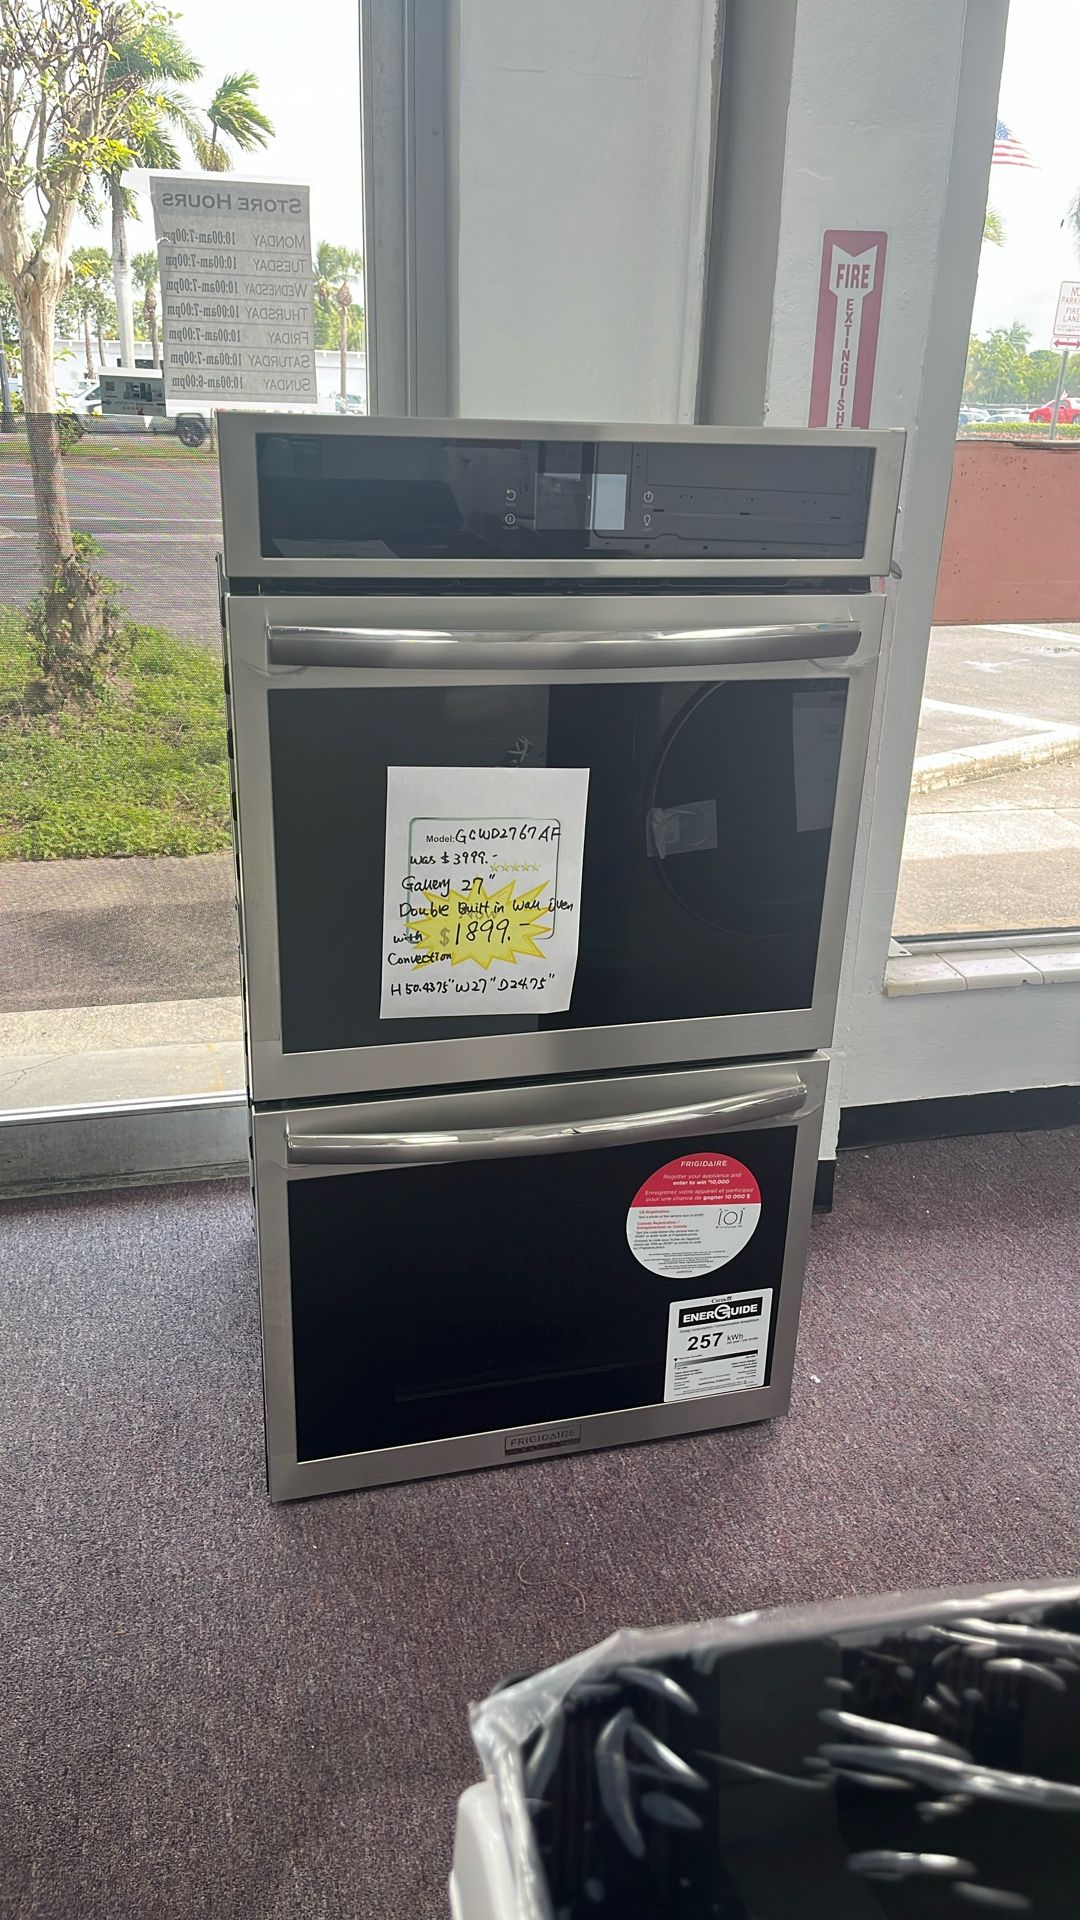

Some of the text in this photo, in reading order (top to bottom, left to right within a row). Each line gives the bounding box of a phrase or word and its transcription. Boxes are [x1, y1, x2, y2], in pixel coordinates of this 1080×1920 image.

[836, 264, 870, 288] FIRE
[402, 876, 450, 897] Gallery
[400, 903, 449, 917] Double
[548, 898, 574, 912] Oven
[394, 932, 422, 944] with
[388, 952, 452, 966] Convection
[687, 1332, 724, 1351] 257
[727, 1334, 744, 1342] kWh
[510, 1429, 576, 1446] FRIGIDAIRE
